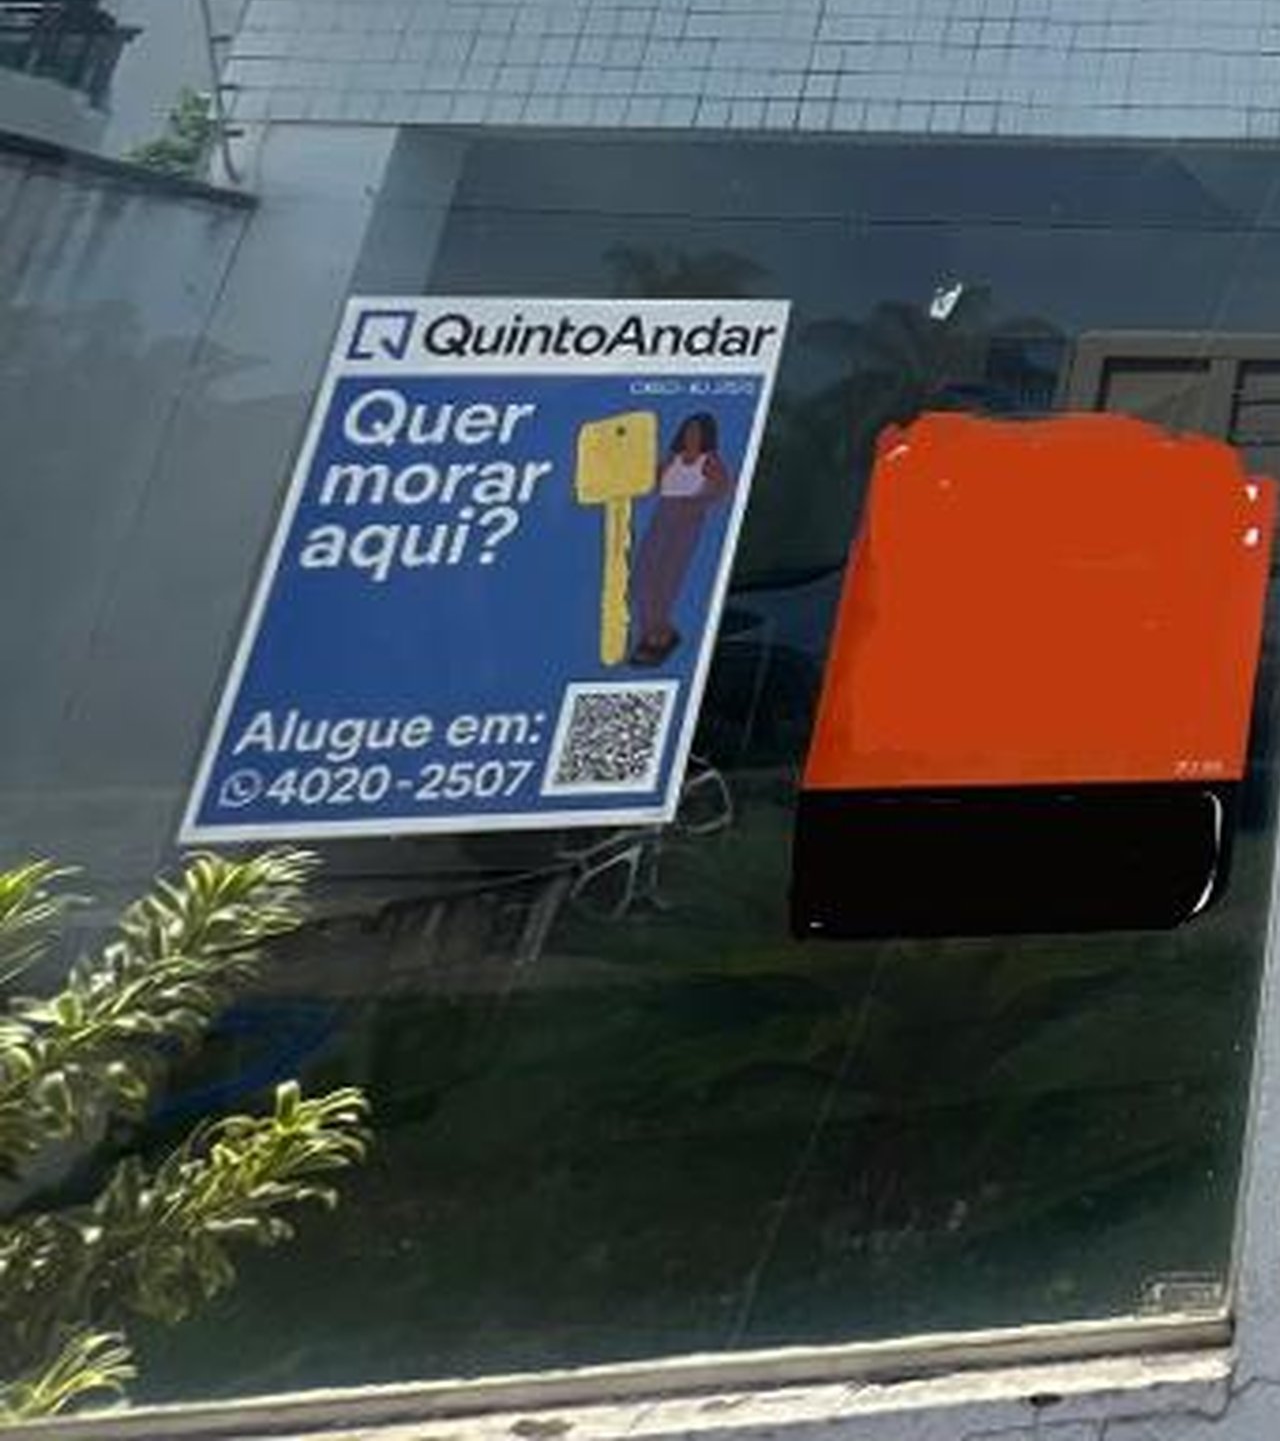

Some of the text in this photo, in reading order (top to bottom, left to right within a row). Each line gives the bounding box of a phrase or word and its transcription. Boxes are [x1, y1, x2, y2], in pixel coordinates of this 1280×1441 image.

[423, 314, 776, 359] QuintoAndar
[343, 389, 536, 445] Quer
[319, 459, 553, 505] morar
[299, 507, 519, 582] aqui?
[232, 710, 545, 762] Alugue em:
